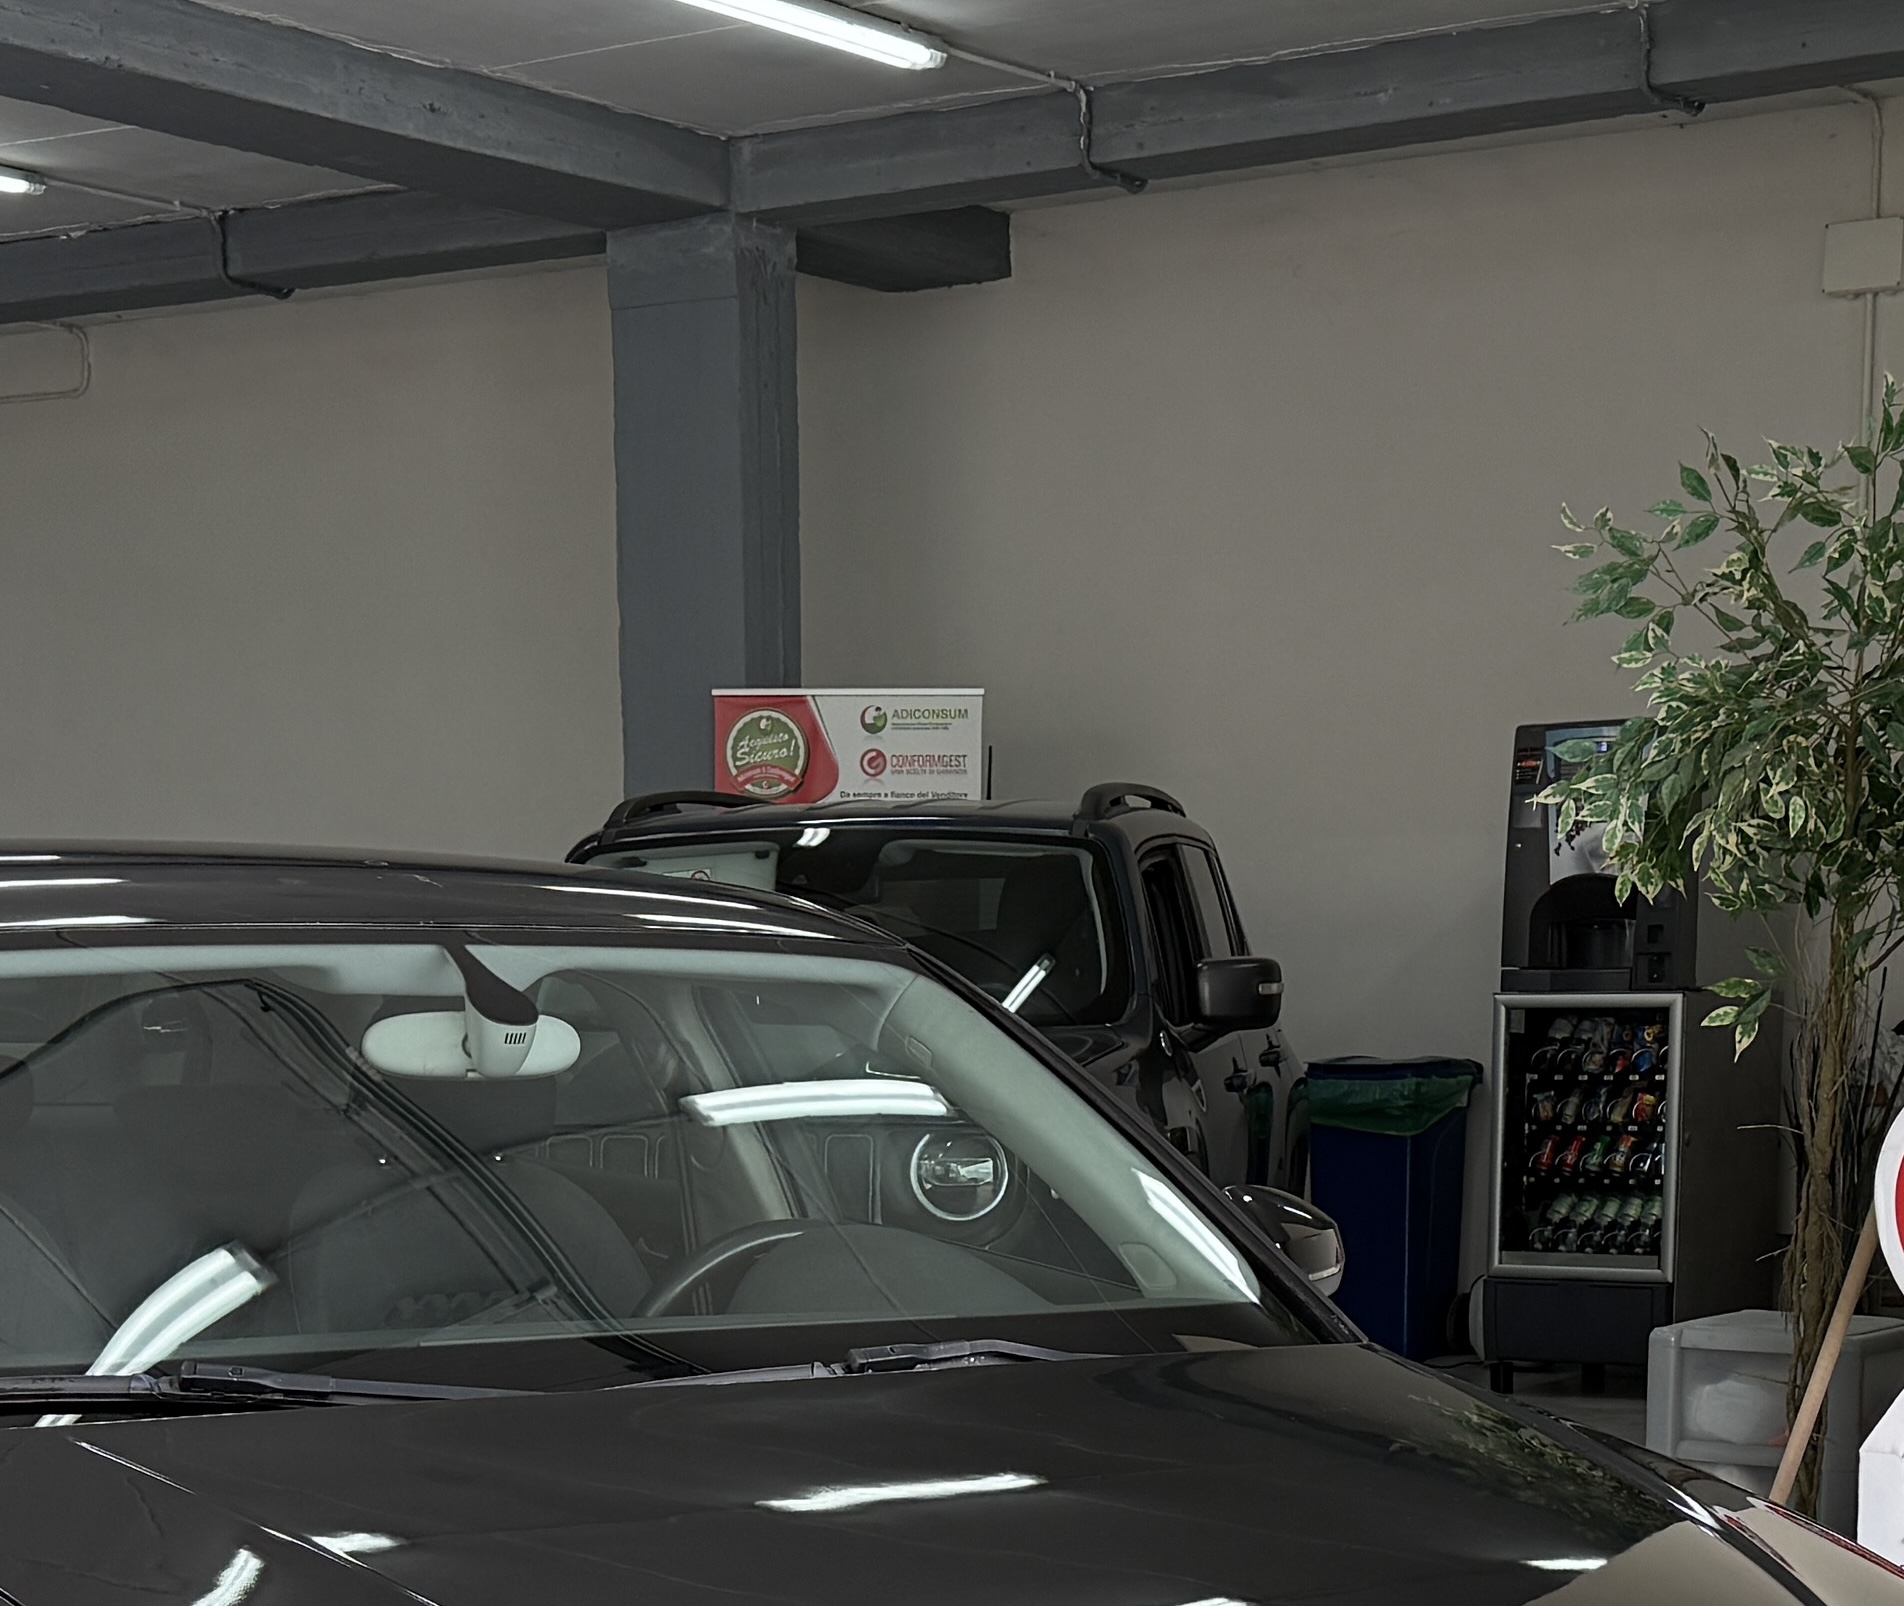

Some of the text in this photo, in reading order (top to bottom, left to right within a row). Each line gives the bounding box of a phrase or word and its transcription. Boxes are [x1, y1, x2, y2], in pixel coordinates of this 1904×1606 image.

[892, 708, 969, 720] ADICONSUM
[890, 754, 968, 768] CONFORMGEST
[918, 791, 929, 799] del
